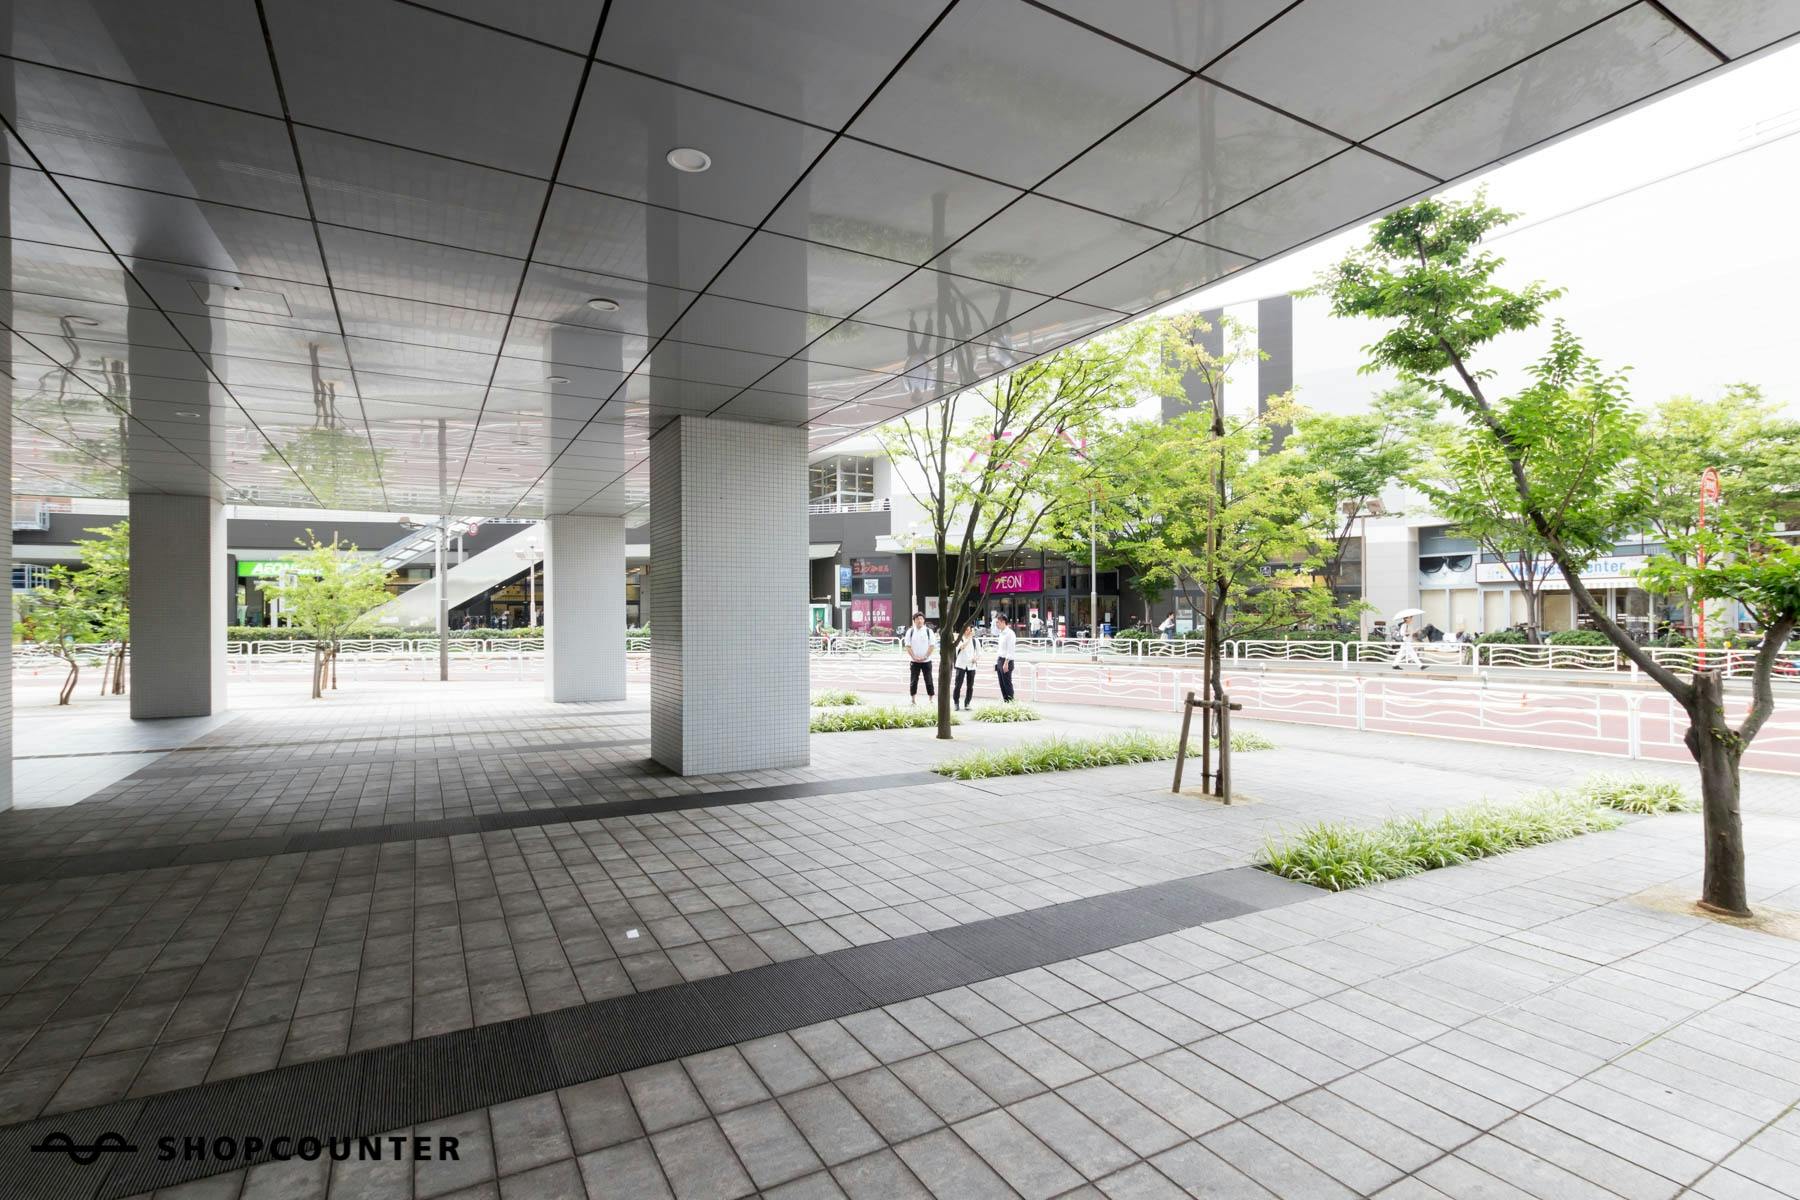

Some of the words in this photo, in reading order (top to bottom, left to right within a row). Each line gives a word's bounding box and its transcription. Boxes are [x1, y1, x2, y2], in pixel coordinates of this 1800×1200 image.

[1511, 561, 1566, 576] Wllnes
[1579, 560, 1626, 573] enter
[995, 575, 1022, 590] AEON
